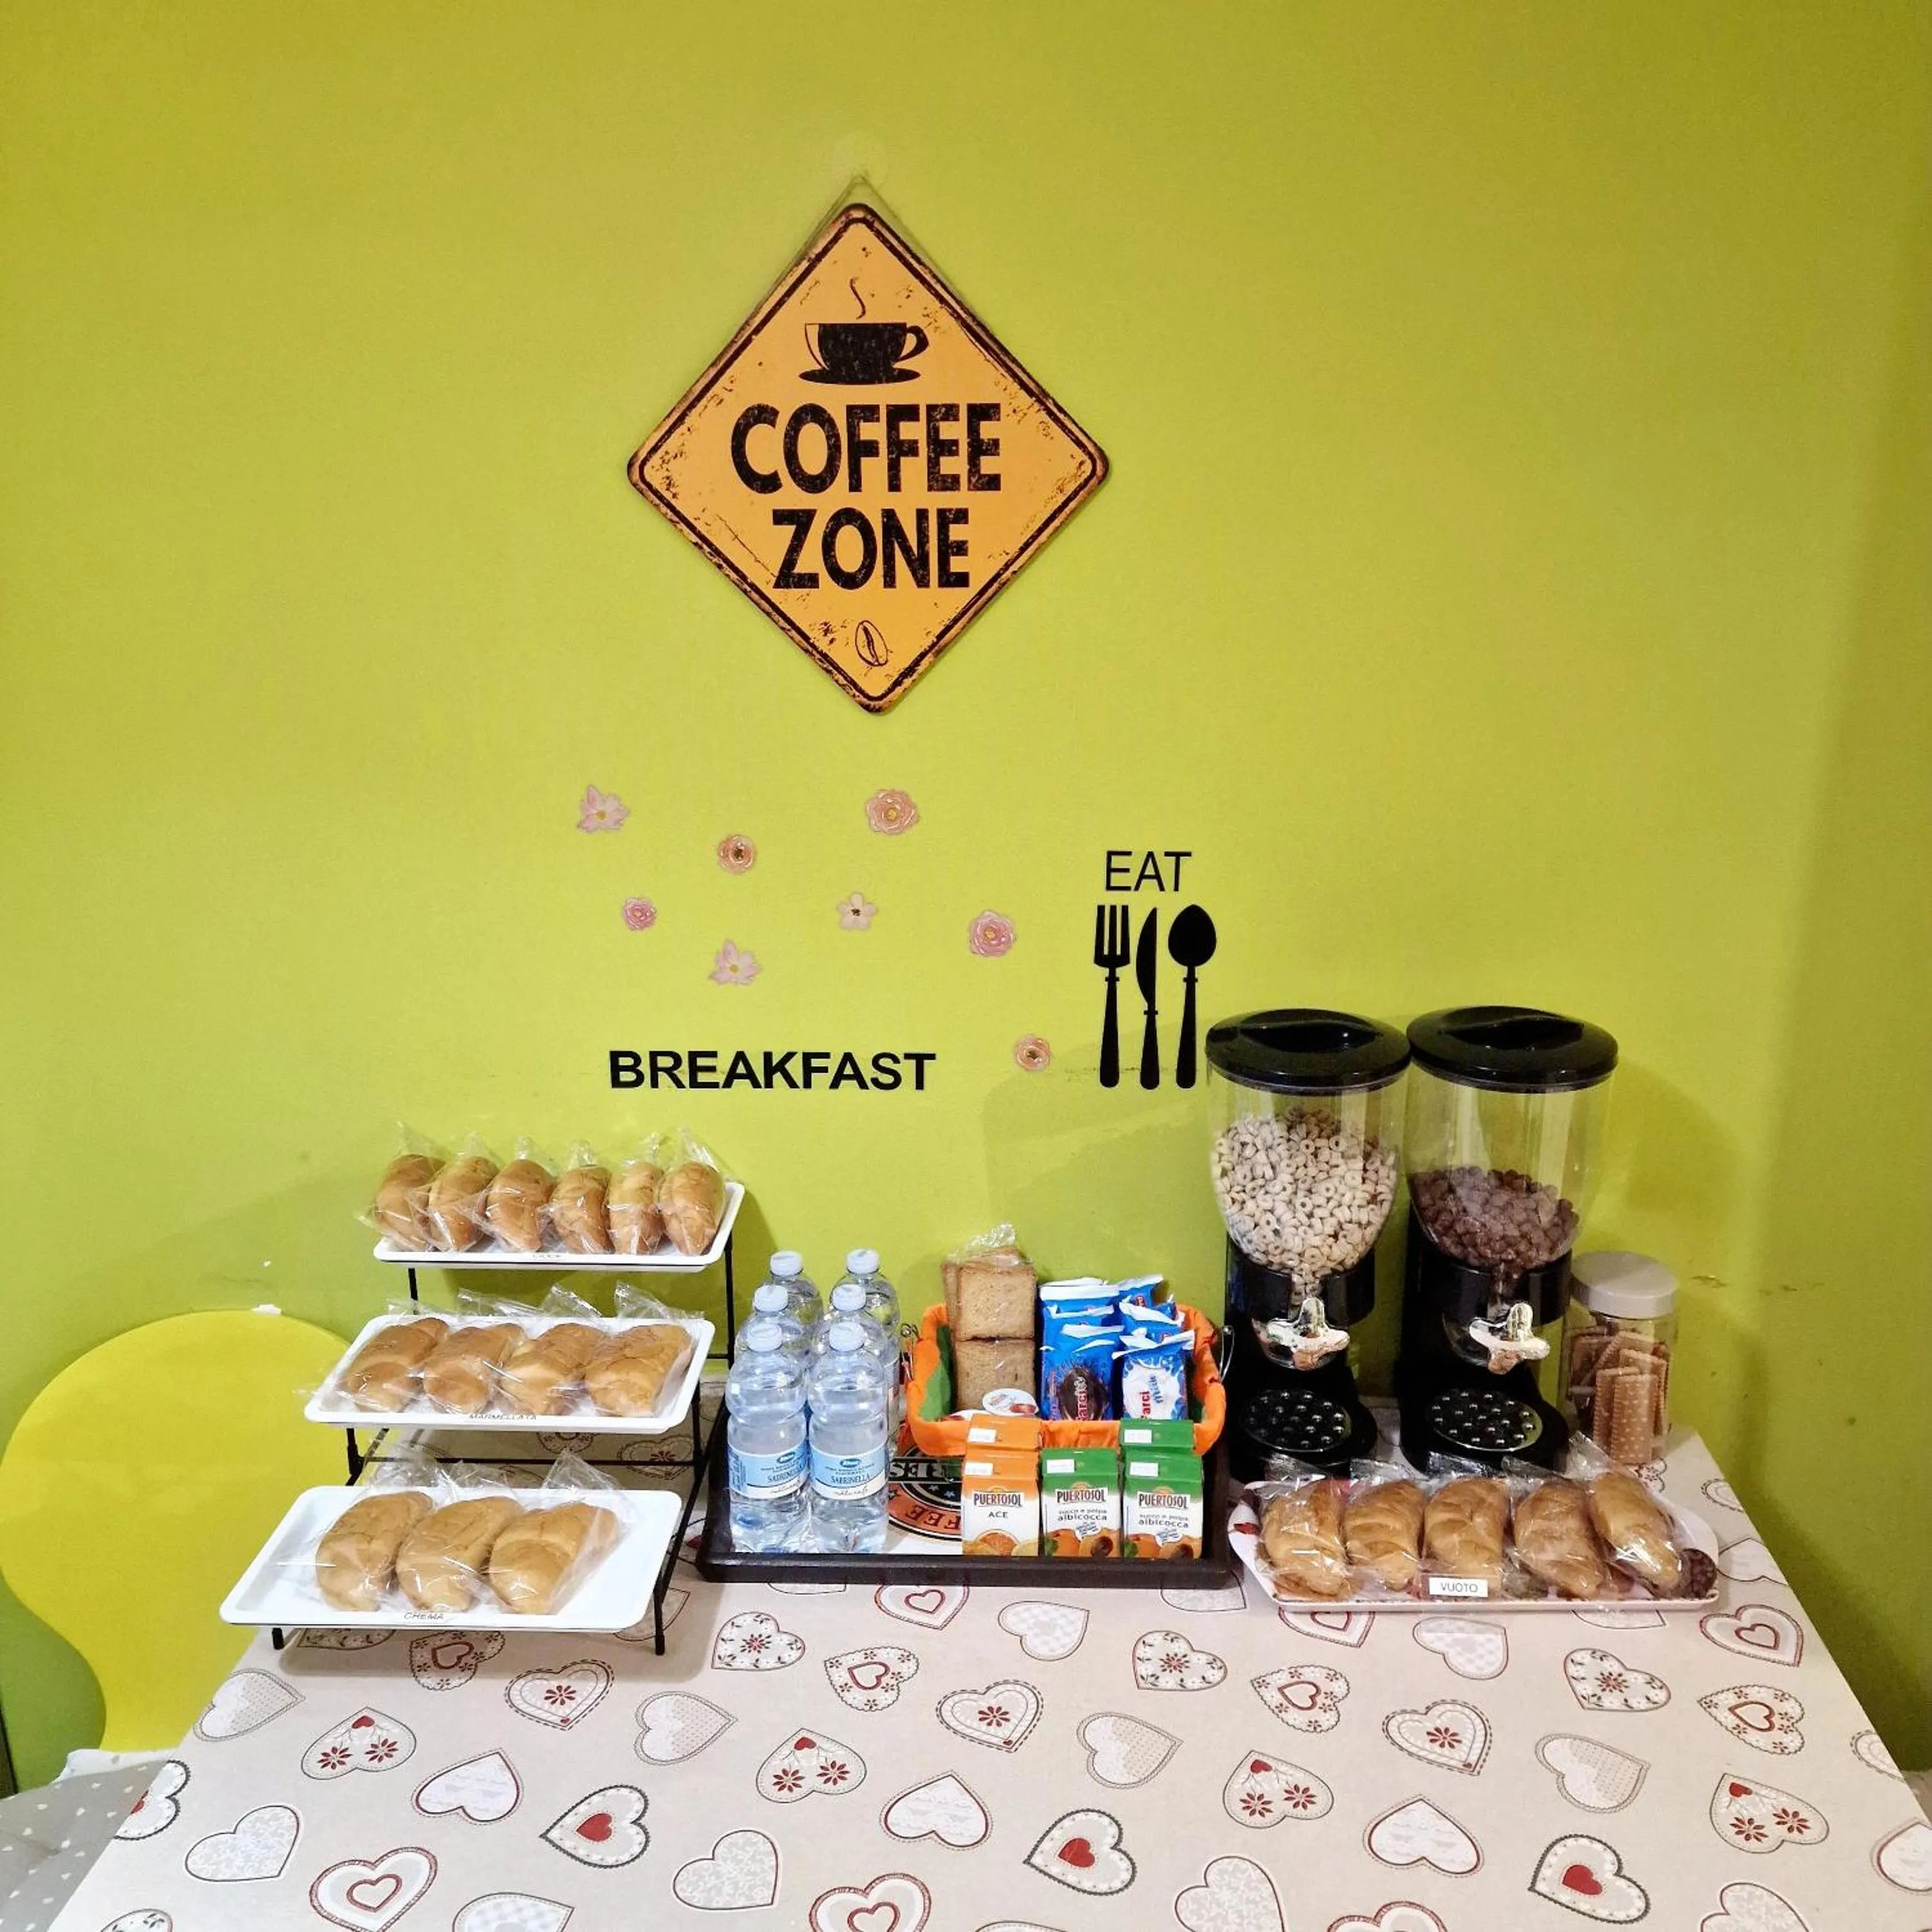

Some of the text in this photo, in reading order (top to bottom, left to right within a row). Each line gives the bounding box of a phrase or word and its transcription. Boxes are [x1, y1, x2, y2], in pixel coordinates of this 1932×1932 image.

[732, 404, 1000, 493] COFFEE
[773, 508, 969, 590] ZONE
[1106, 851, 1191, 891] EAT
[610, 1051, 936, 1090] BREAKFAST
[973, 1492, 1022, 1506] PUERTOSOL
[1056, 1489, 1106, 1504] PUERTOSOL
[1138, 1493, 1188, 1510] PUERTOSOL
[1057, 1514, 1107, 1522] albicocca
[1138, 1518, 1189, 1528] albicocca
[1441, 1583, 1478, 1592] VUOTO
